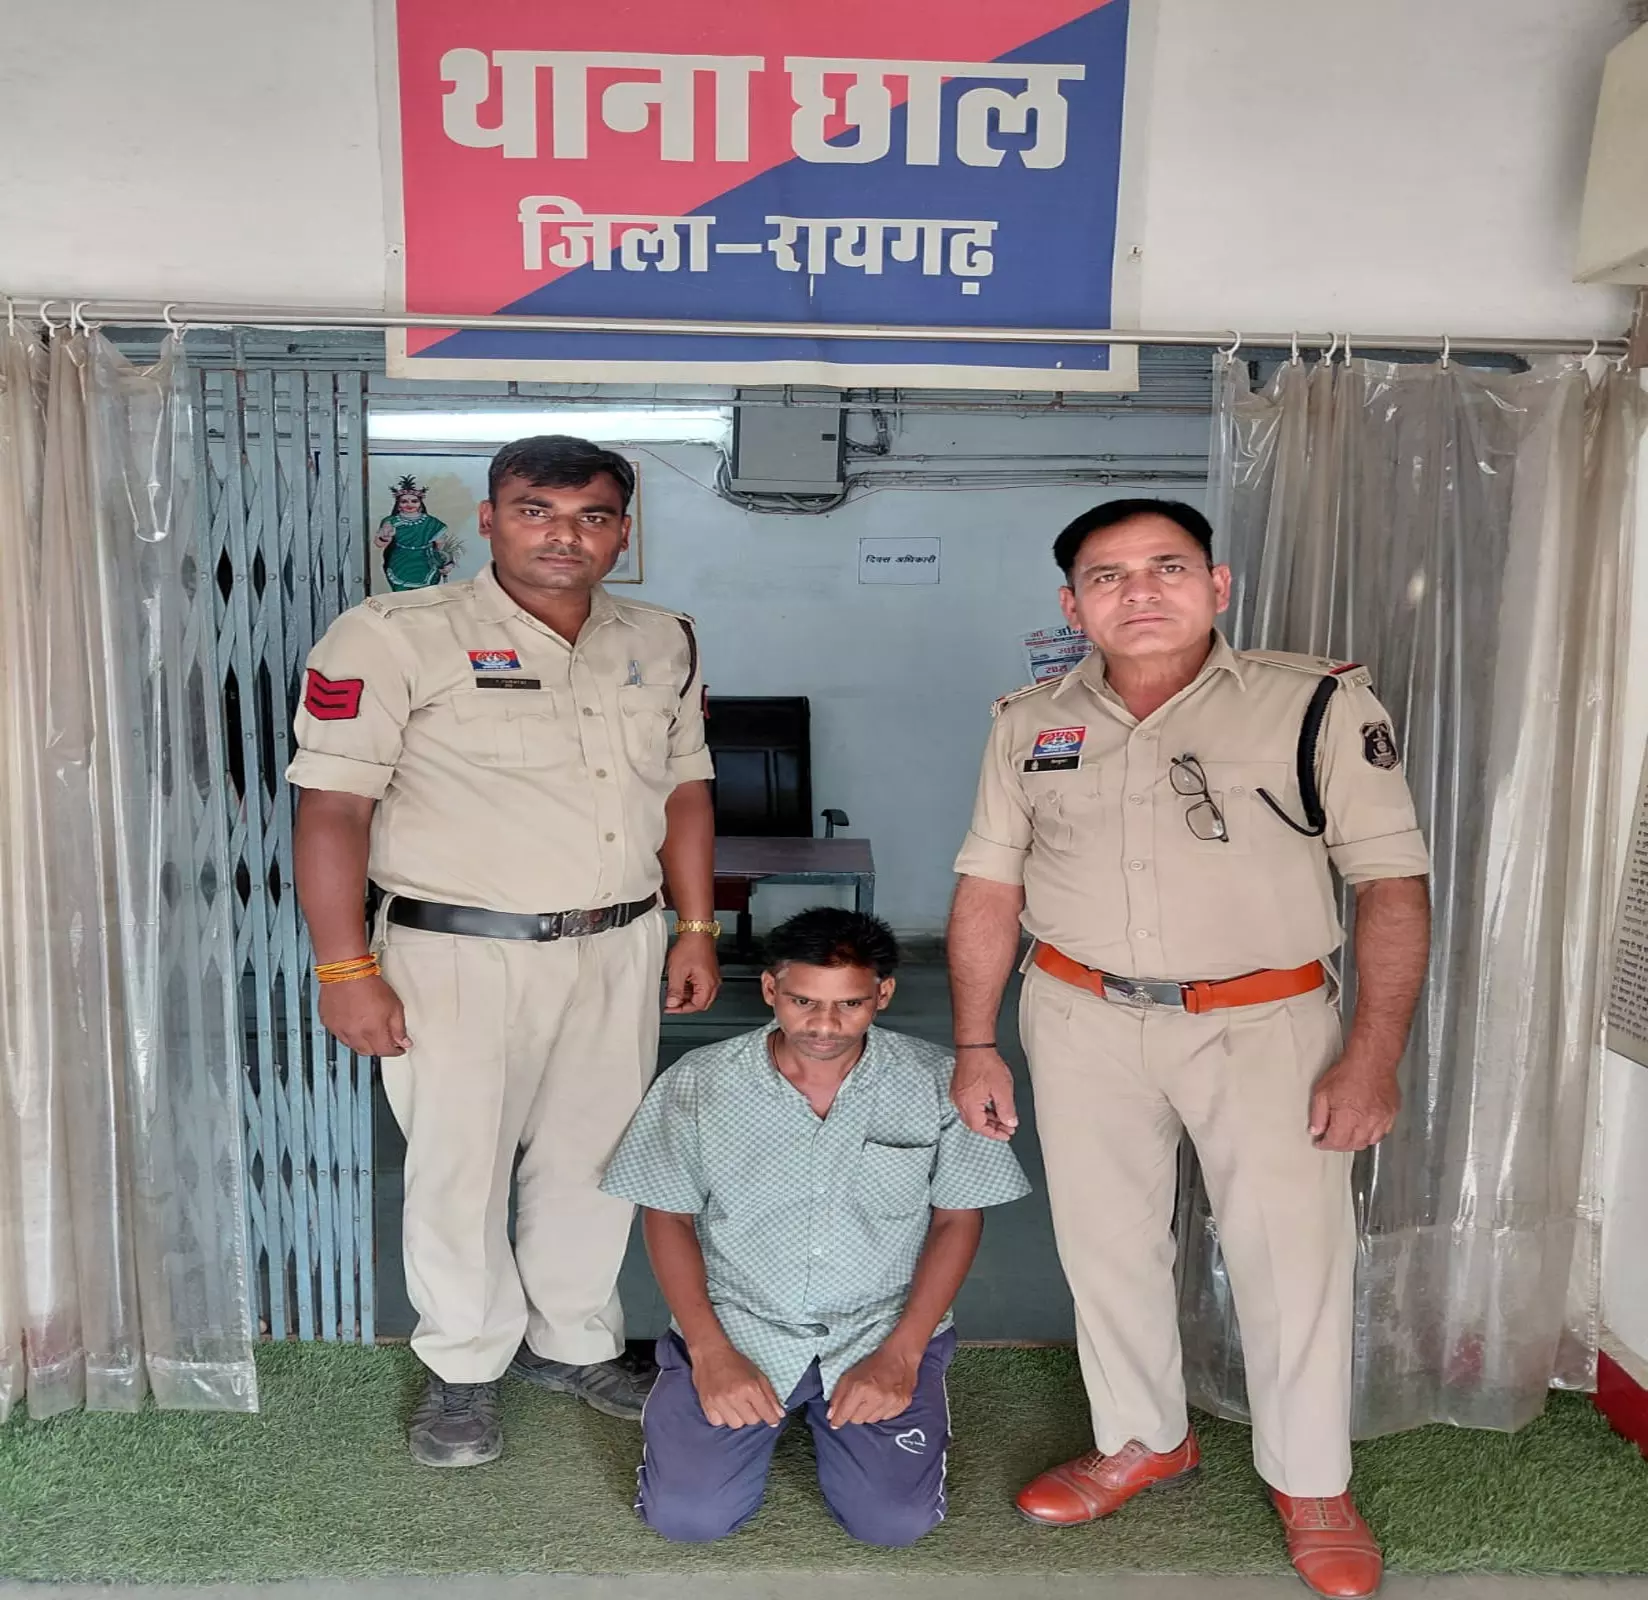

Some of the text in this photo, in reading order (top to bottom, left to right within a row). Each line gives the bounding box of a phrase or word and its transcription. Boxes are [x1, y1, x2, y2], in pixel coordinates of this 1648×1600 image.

[441, 48, 1086, 169] थाना छाल
[895, 554, 936, 563] अधिकारी
